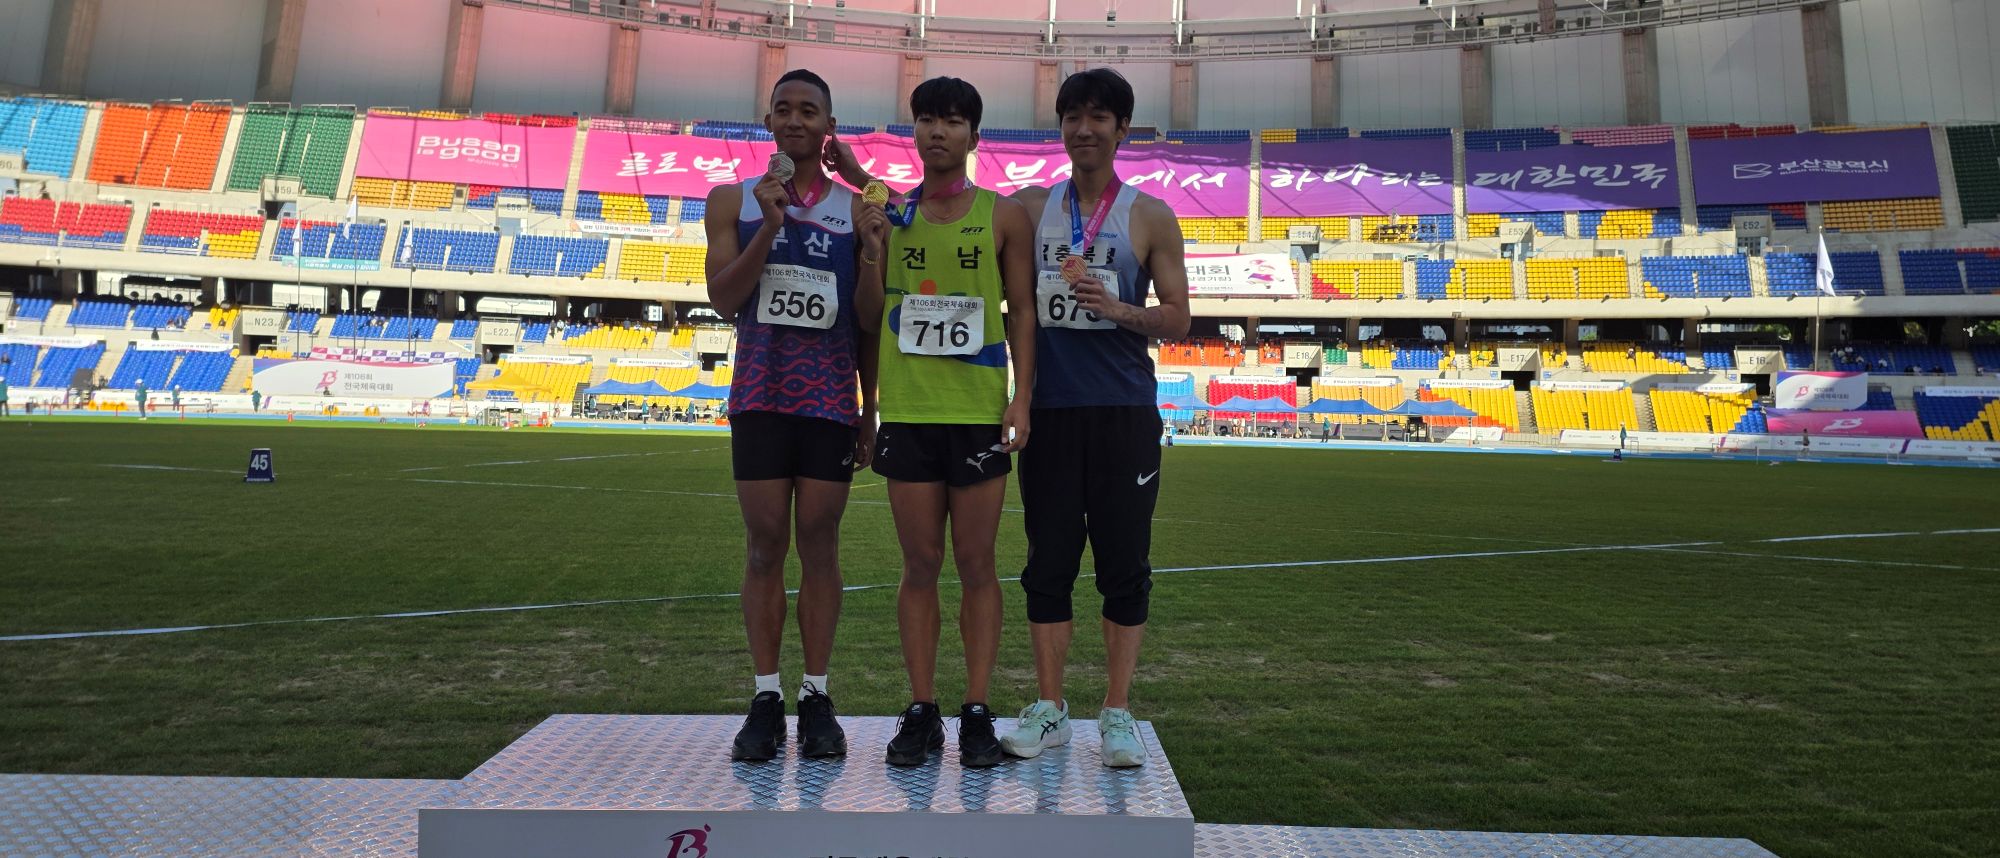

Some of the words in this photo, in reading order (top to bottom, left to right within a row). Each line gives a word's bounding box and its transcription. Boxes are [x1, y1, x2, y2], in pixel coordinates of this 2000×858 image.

[419, 136, 520, 152] Busan
[416, 147, 434, 155] is
[439, 147, 520, 163] good
[616, 152, 741, 182] 글로벌
[1778, 158, 1889, 170] 부산광역시
[995, 159, 1227, 191] 부에서
[1472, 164, 1669, 190] 대한민국
[1744, 221, 1759, 229] E52
[768, 290, 825, 321] 556
[909, 298, 978, 309] 제106회전국체육대회
[254, 318, 274, 327] N23
[493, 328, 509, 336] E22
[912, 320, 970, 348] 716
[344, 373, 373, 381] 제106회
[344, 382, 394, 391] 전국체육대회
[250, 454, 269, 471] 45
